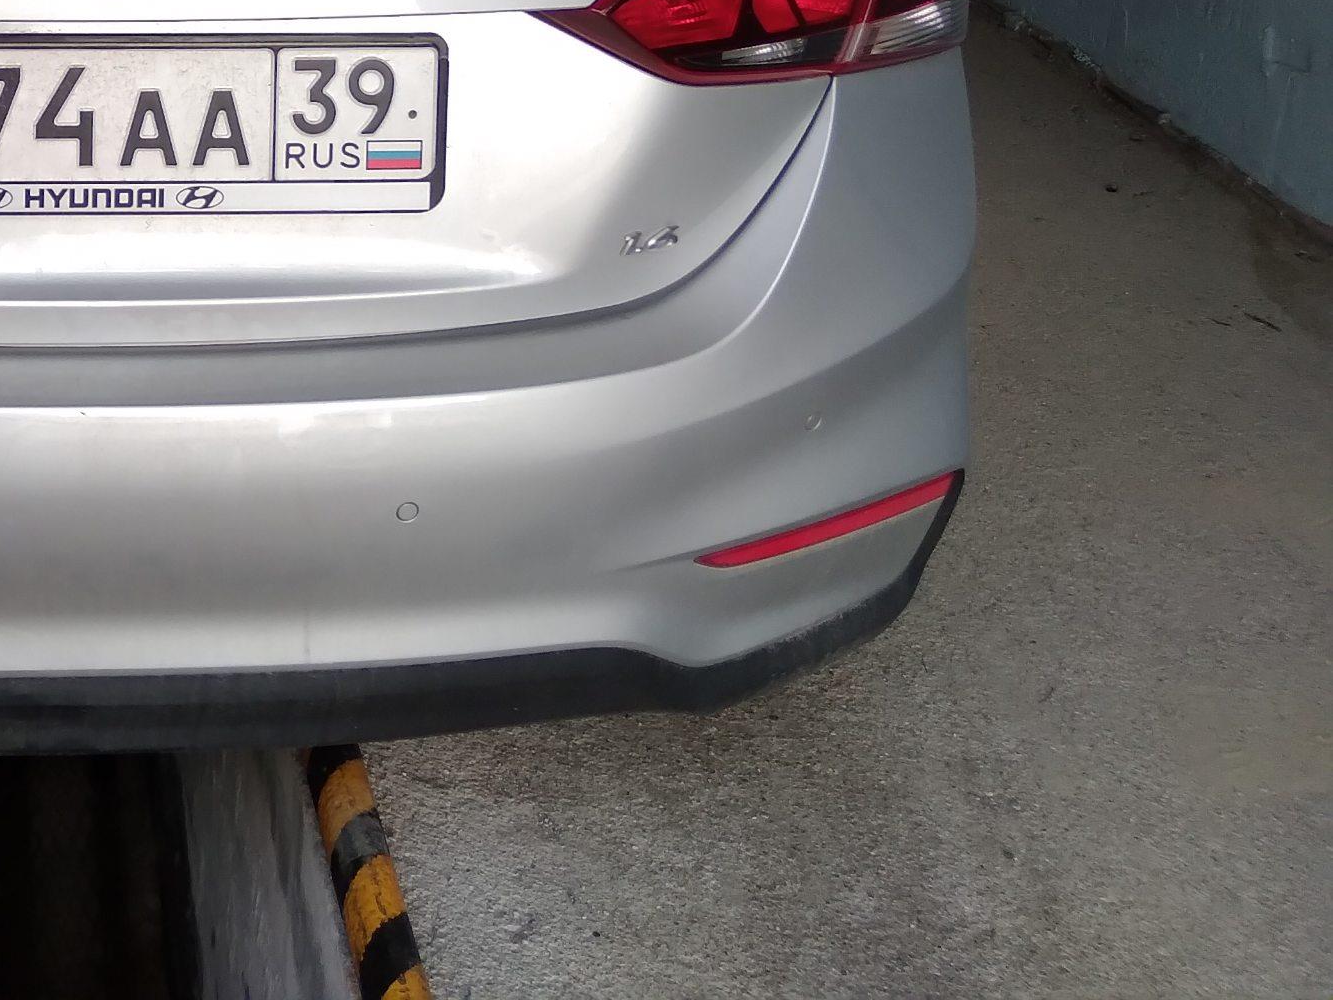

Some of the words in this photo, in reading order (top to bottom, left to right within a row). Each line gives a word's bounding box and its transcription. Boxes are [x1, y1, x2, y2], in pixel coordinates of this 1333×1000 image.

[292, 58, 395, 135] 39
[285, 142, 360, 169] RUS
[24, 188, 164, 209] HYUNDAI
